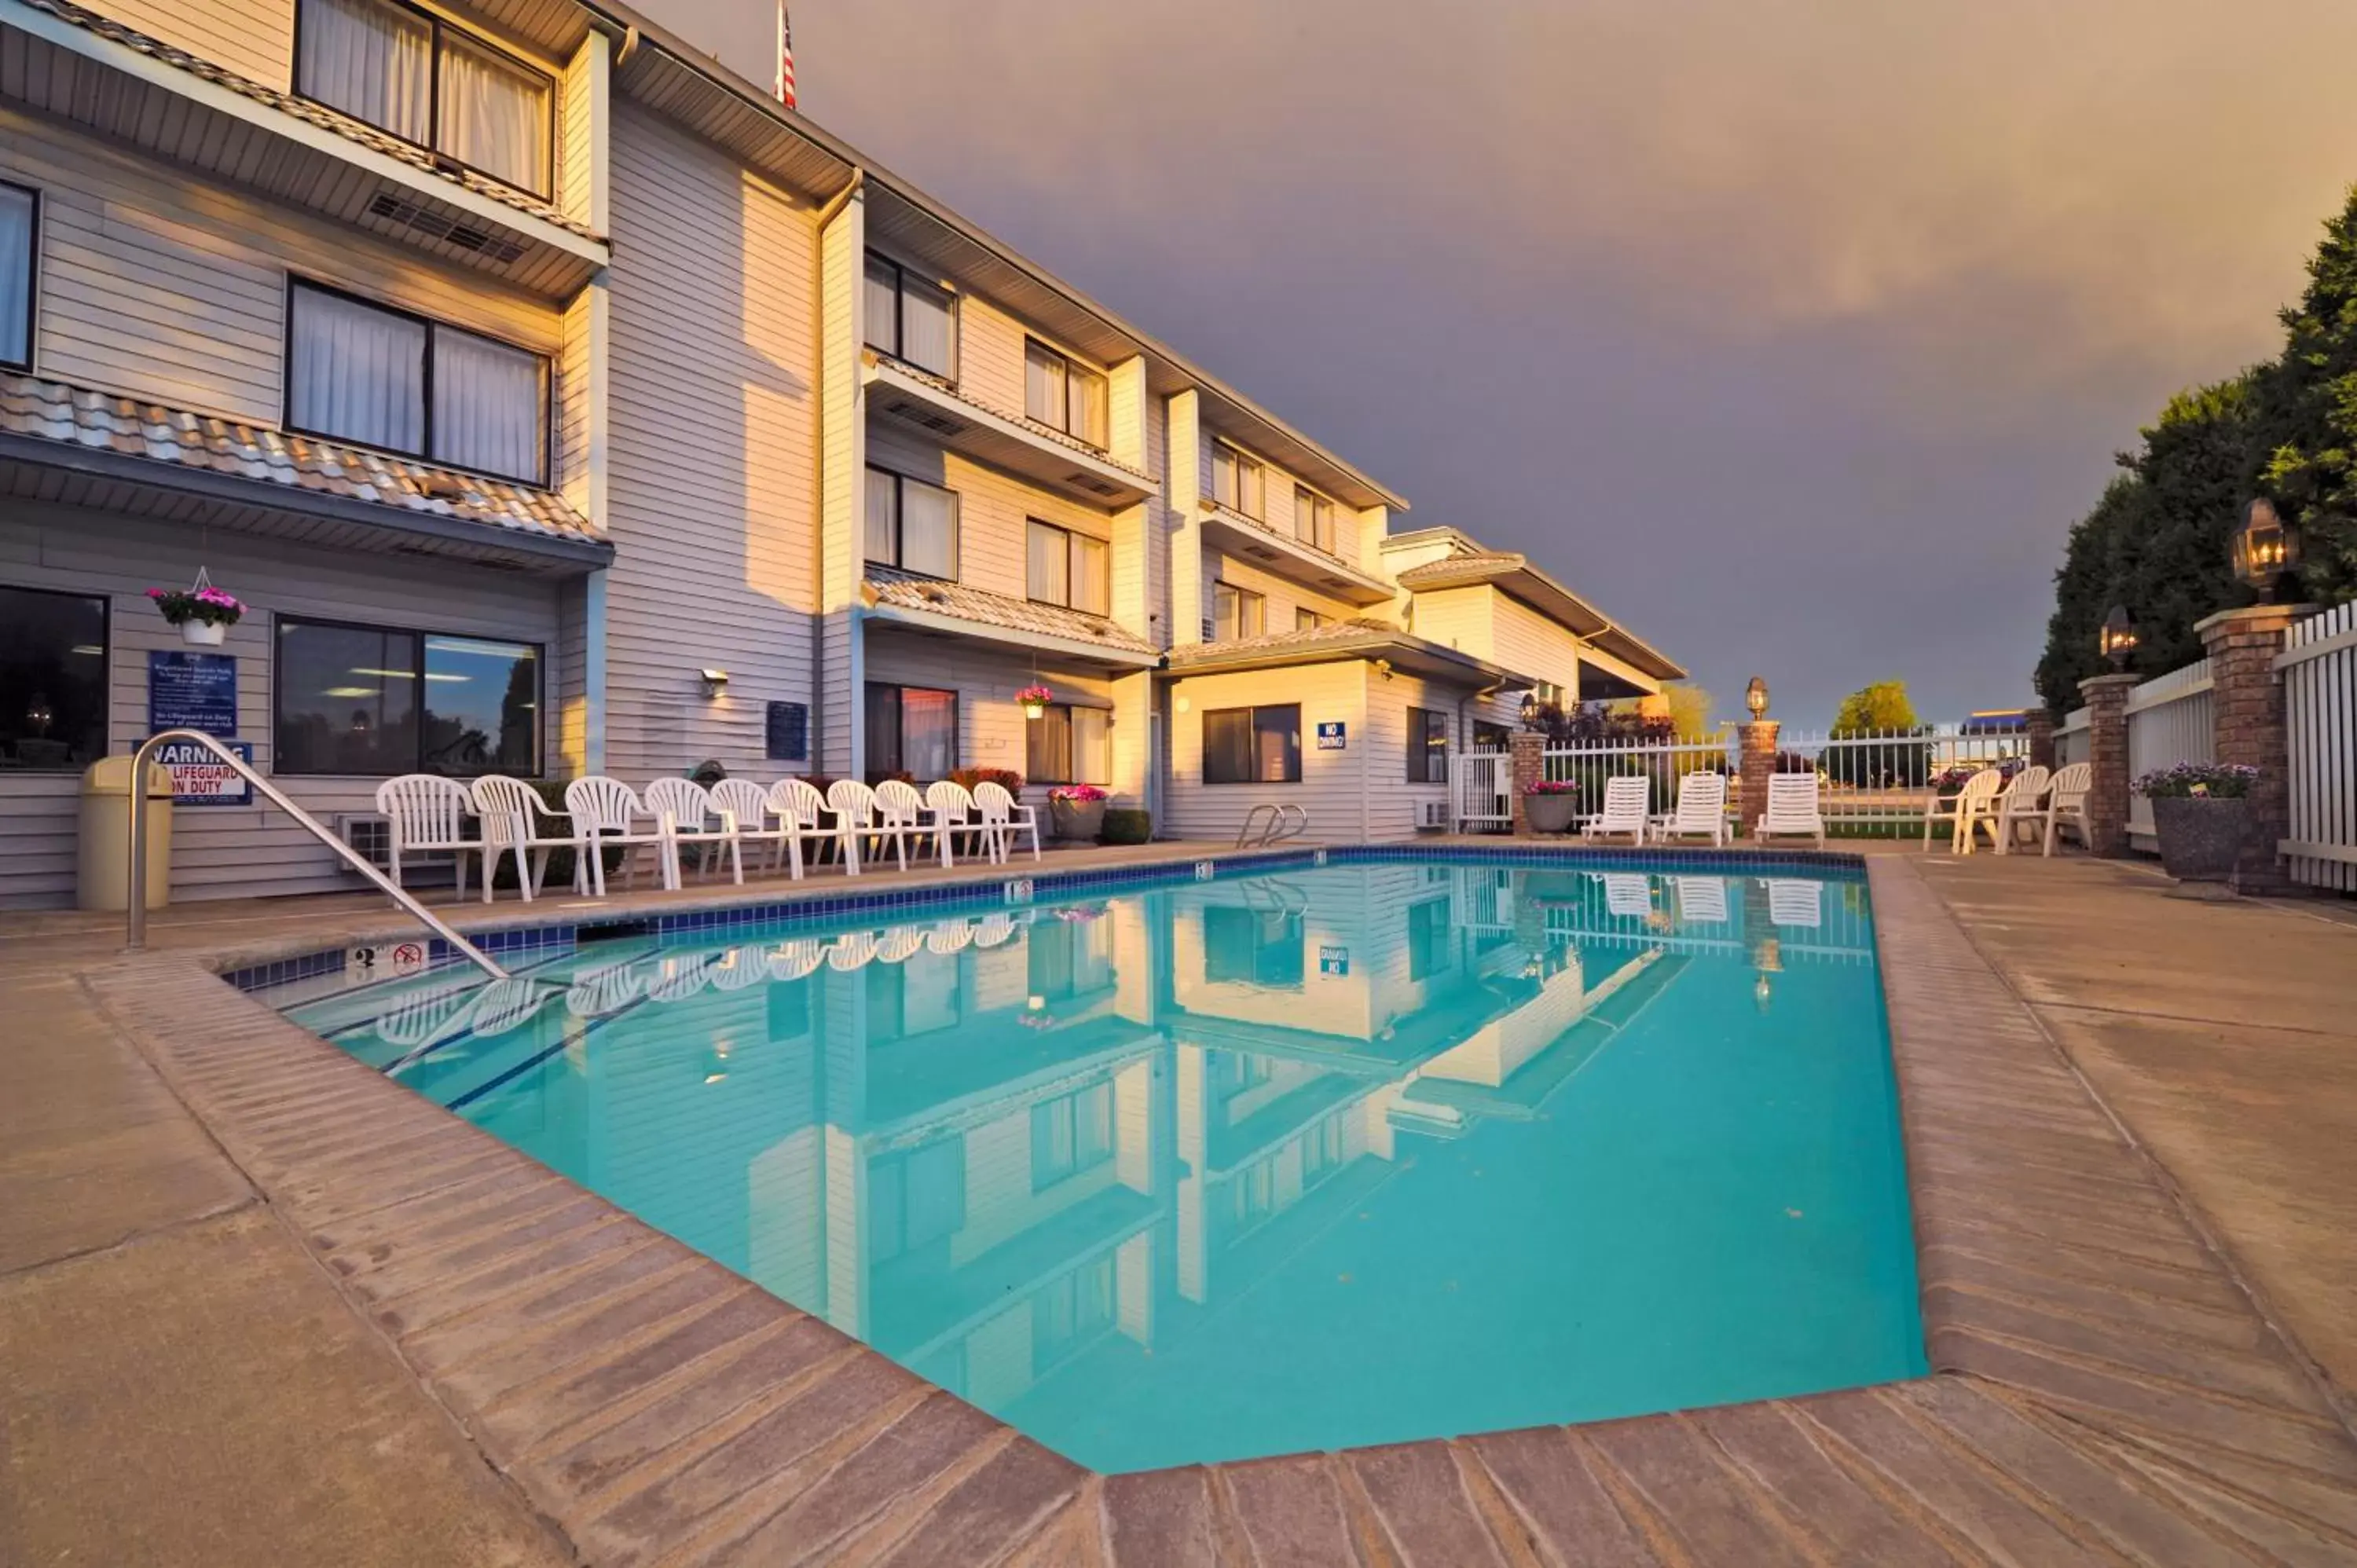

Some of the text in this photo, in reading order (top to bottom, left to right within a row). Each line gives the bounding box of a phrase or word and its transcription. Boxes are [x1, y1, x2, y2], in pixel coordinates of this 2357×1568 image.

[1325, 724, 1336, 735] NO
[153, 746, 244, 763] ARNIG
[174, 767, 238, 779] LIFEGUARD
[191, 781, 222, 793] DUTY
